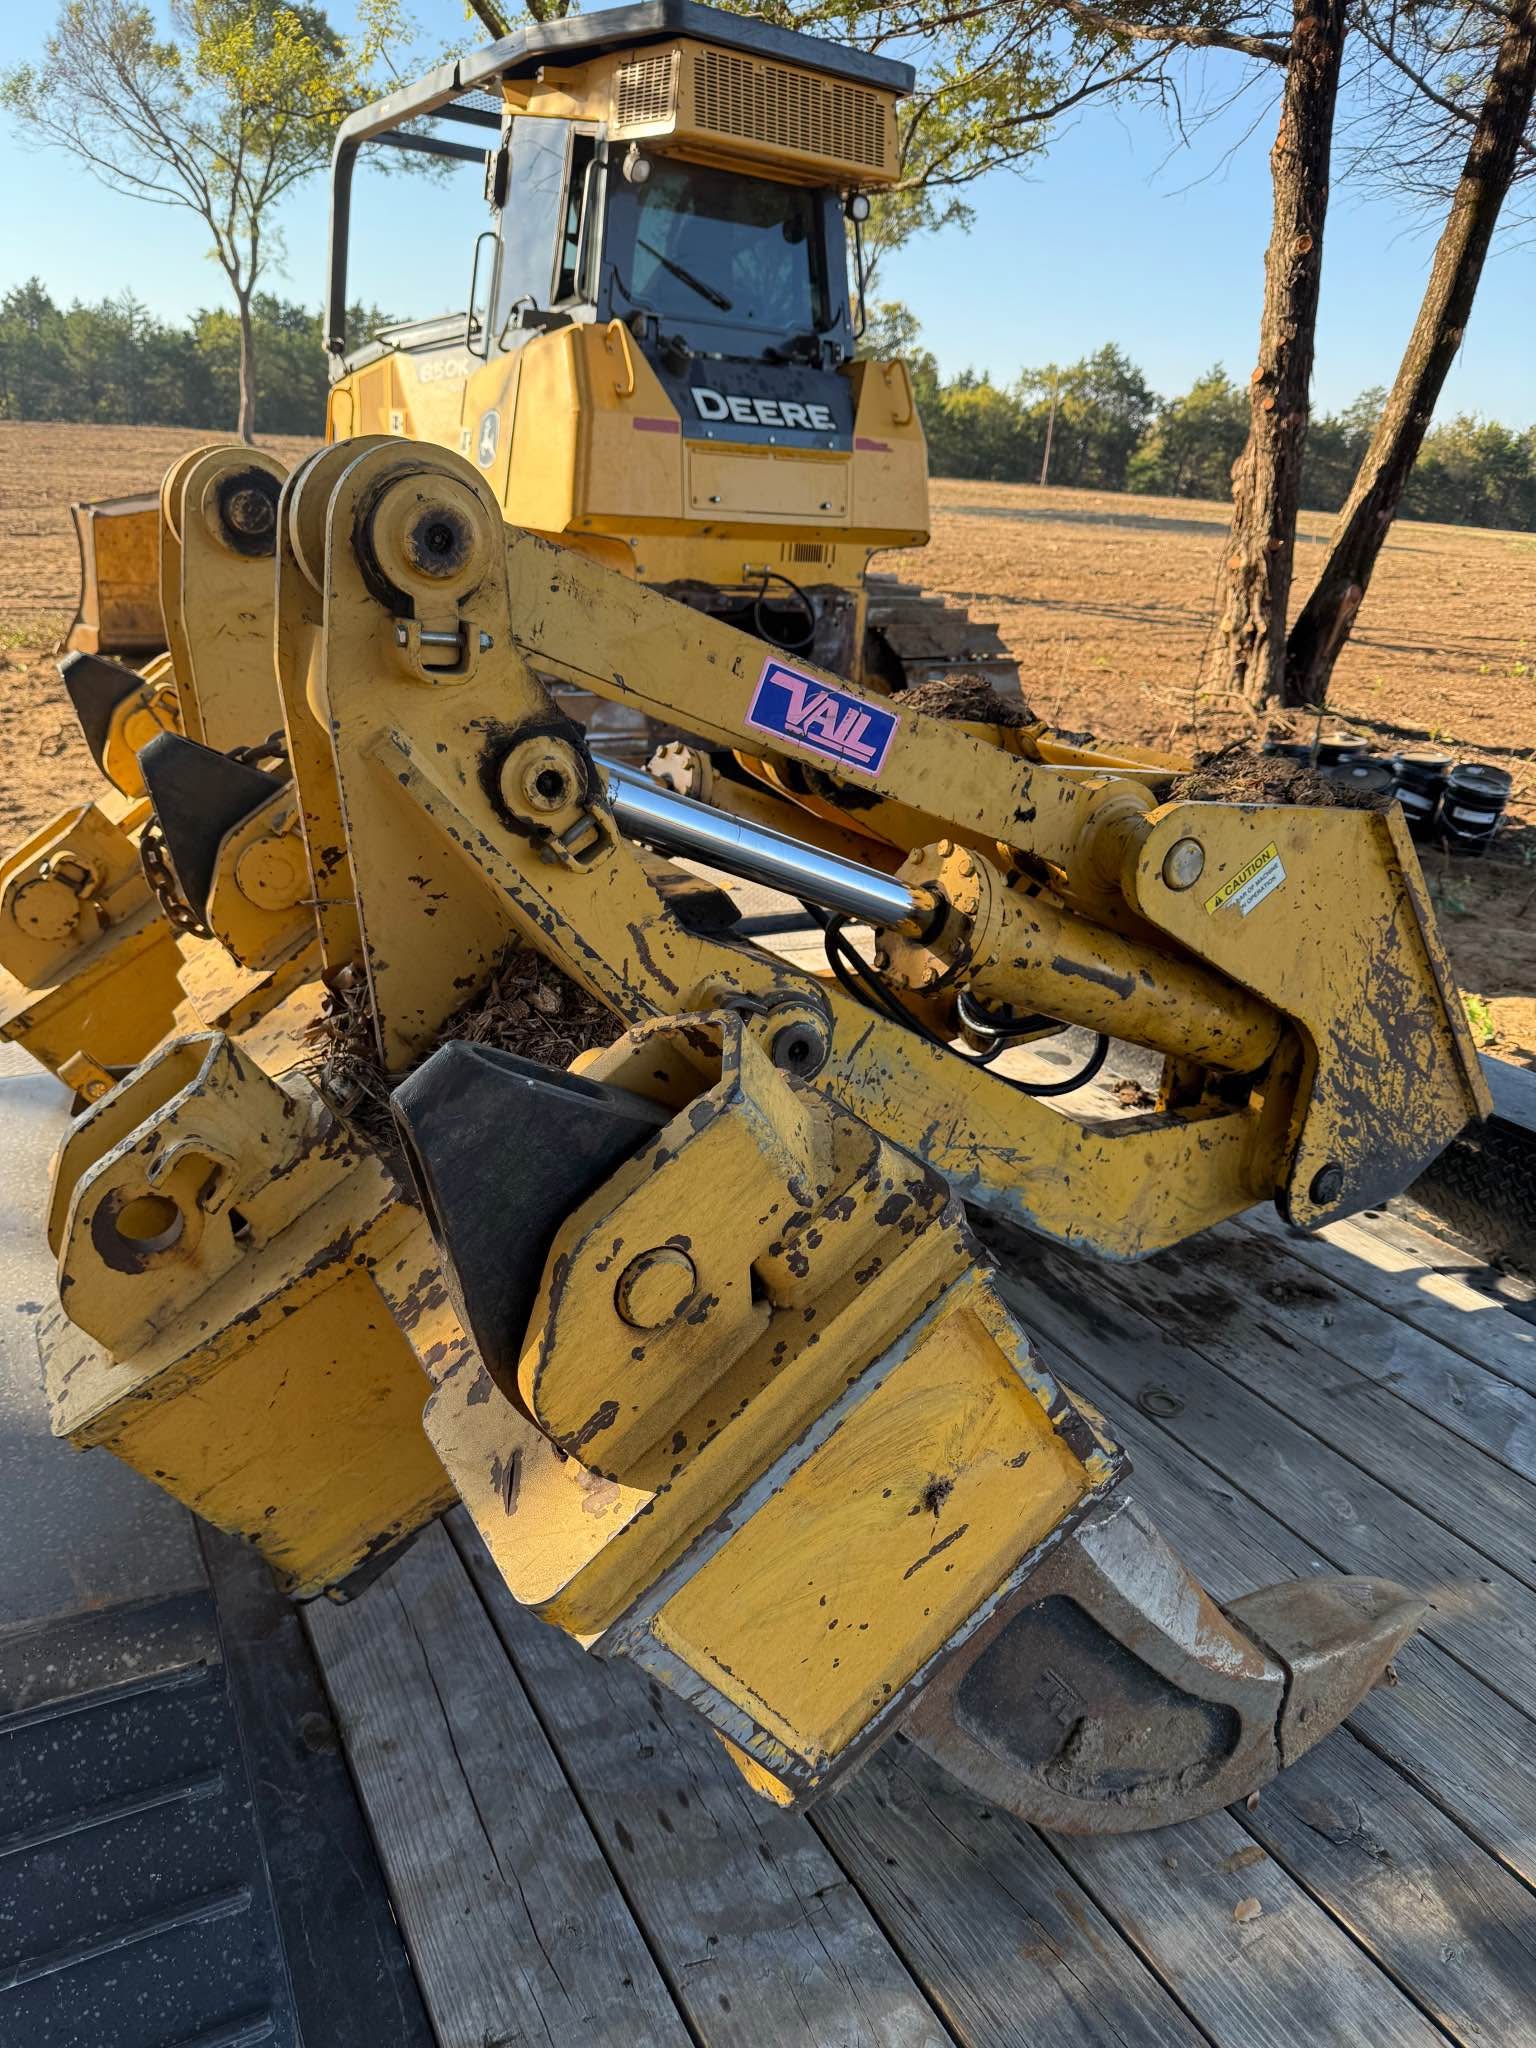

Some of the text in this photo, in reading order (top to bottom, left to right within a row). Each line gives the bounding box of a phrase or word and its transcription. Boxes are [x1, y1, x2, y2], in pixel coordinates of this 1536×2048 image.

[691, 387, 836, 430] DEERE
[770, 671, 876, 757] VAIL
[1225, 850, 1270, 896] CAUTION
[1247, 877, 1276, 904] OPERATION
